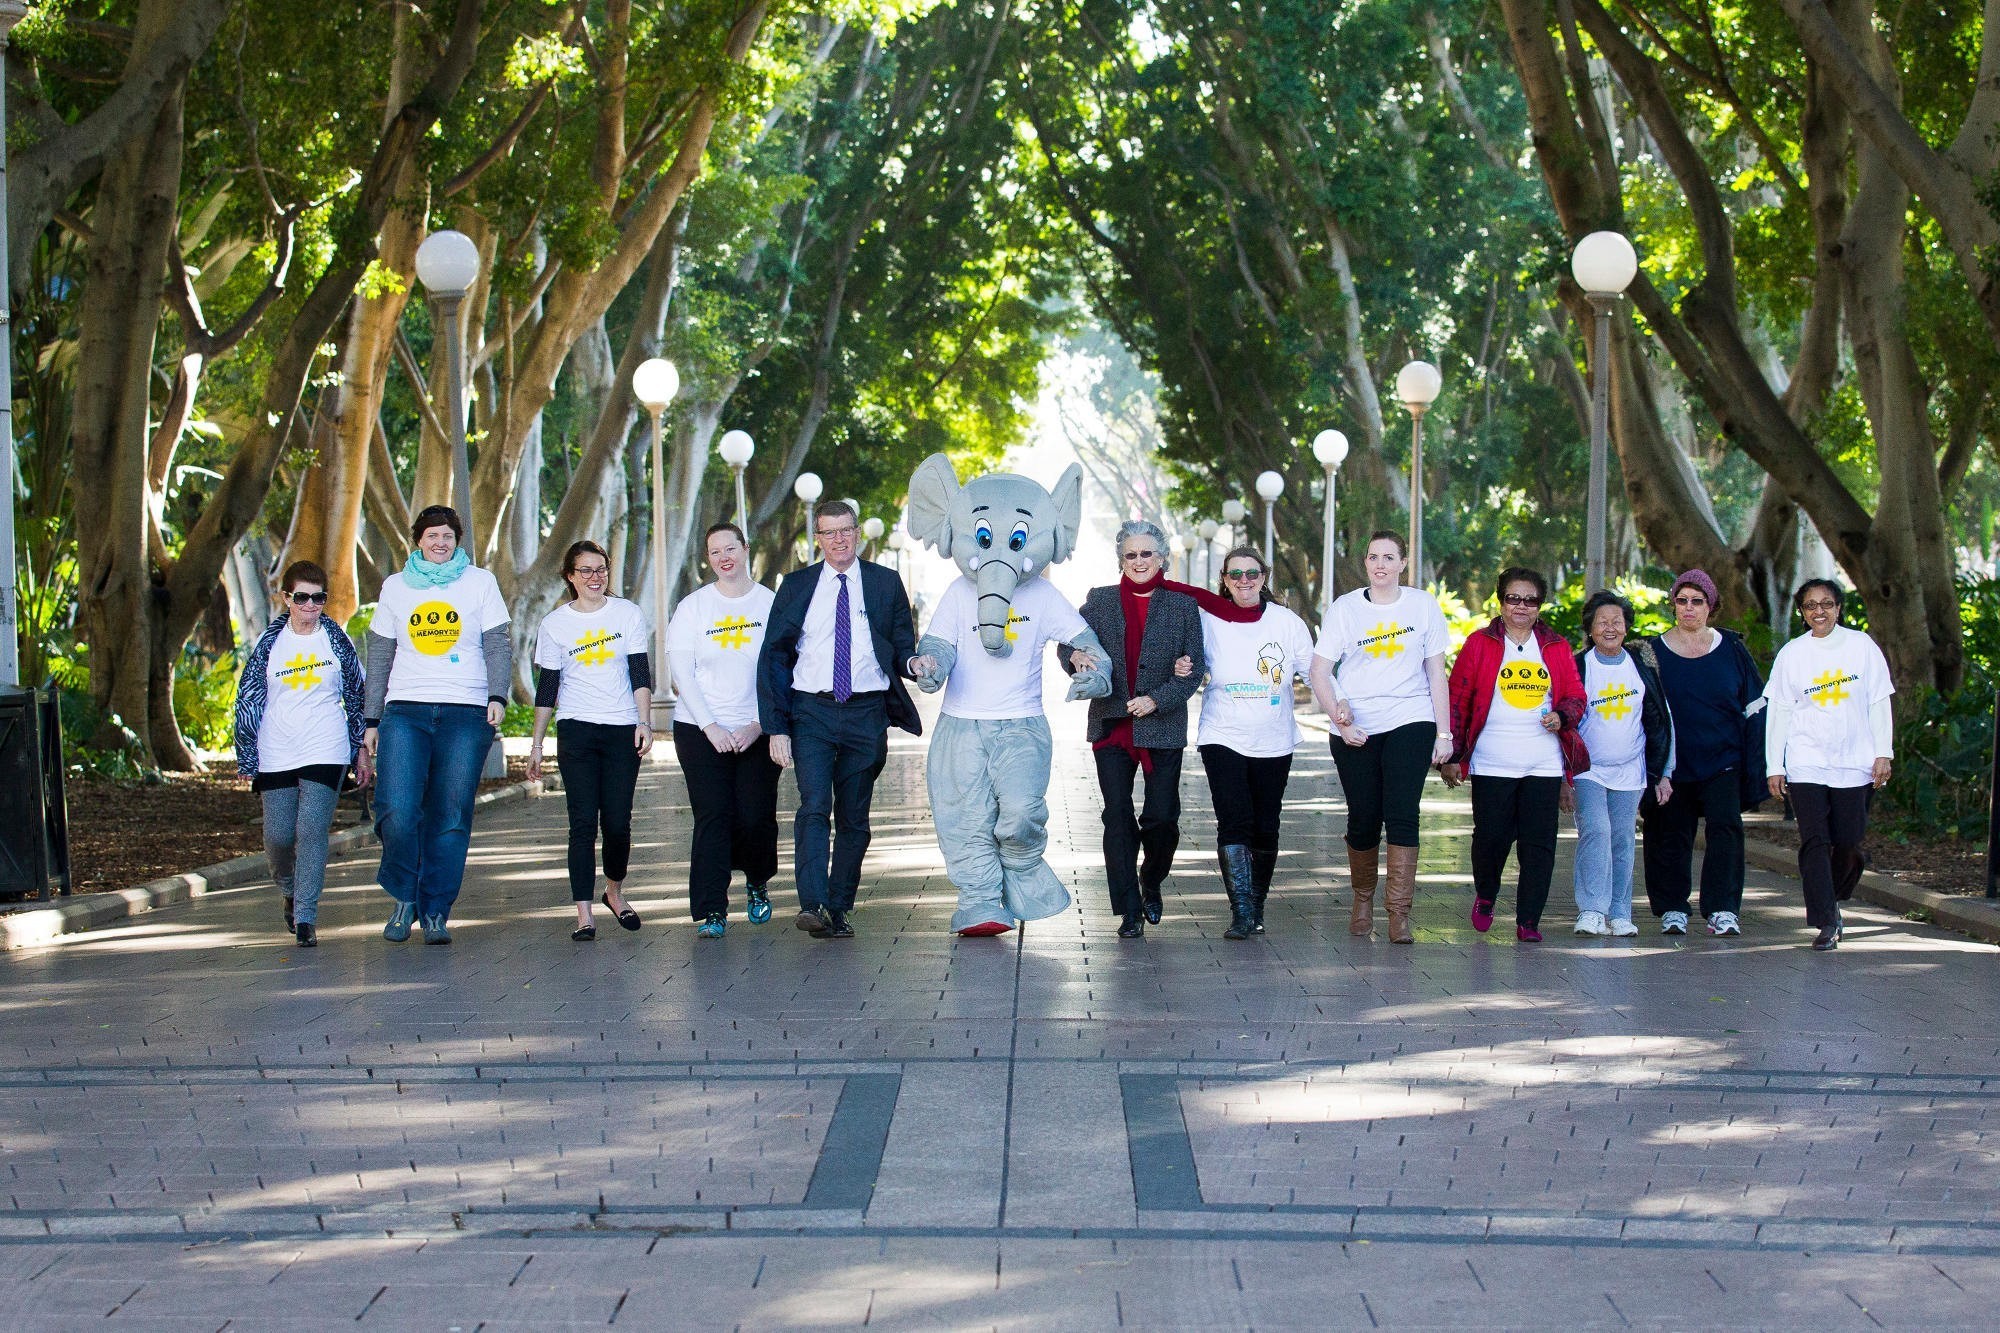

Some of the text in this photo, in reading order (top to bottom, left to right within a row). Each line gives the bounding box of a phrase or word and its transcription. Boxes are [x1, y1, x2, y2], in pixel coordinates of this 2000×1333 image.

[706, 622, 762, 635] #memorywalk
[972, 616, 1031, 631] #ywalk
[416, 629, 448, 637] MEMORY
[1357, 626, 1415, 646] #memorywalk
[568, 632, 622, 656] #memorywalk
[275, 660, 333, 677] #memorywalk
[1804, 674, 1859, 694] #memorywalk
[1590, 689, 1639, 706] #memorywalk
